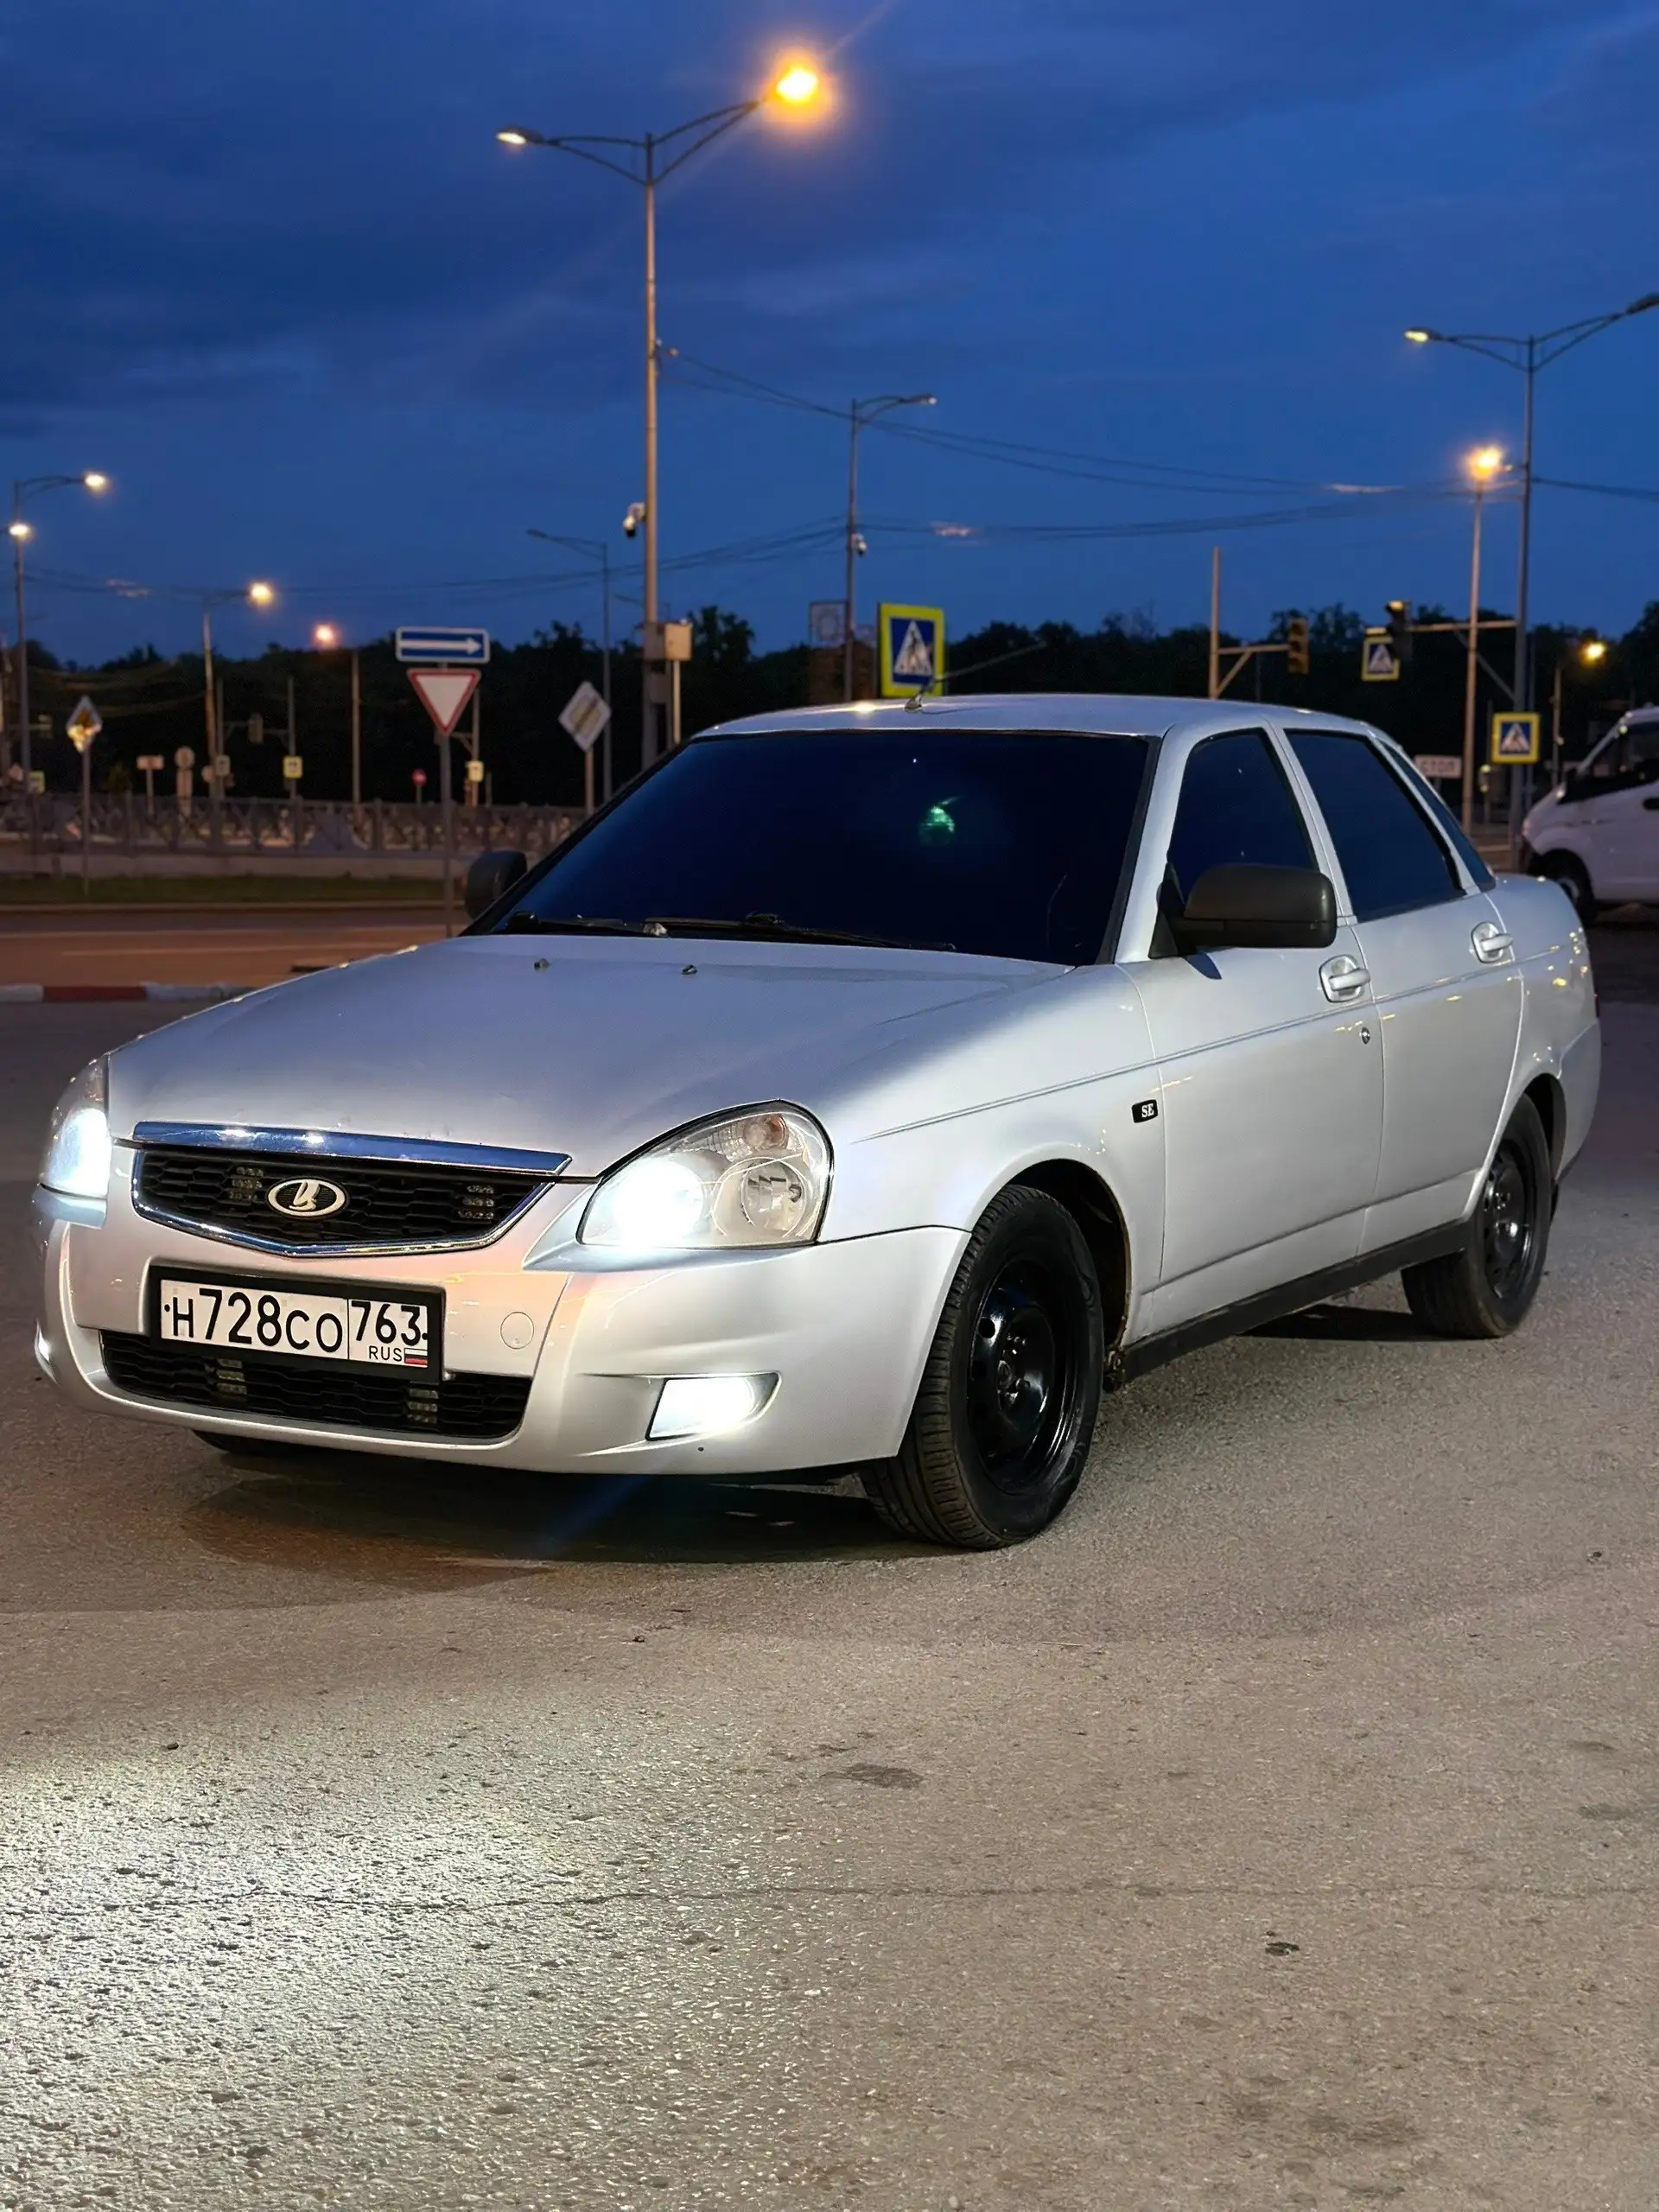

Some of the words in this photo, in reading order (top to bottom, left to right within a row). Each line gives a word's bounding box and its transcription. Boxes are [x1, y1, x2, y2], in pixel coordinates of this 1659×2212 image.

[173, 1288, 343, 1353] Н728СО
[351, 1300, 421, 1346] 763
[369, 1345, 402, 1363] RUS
